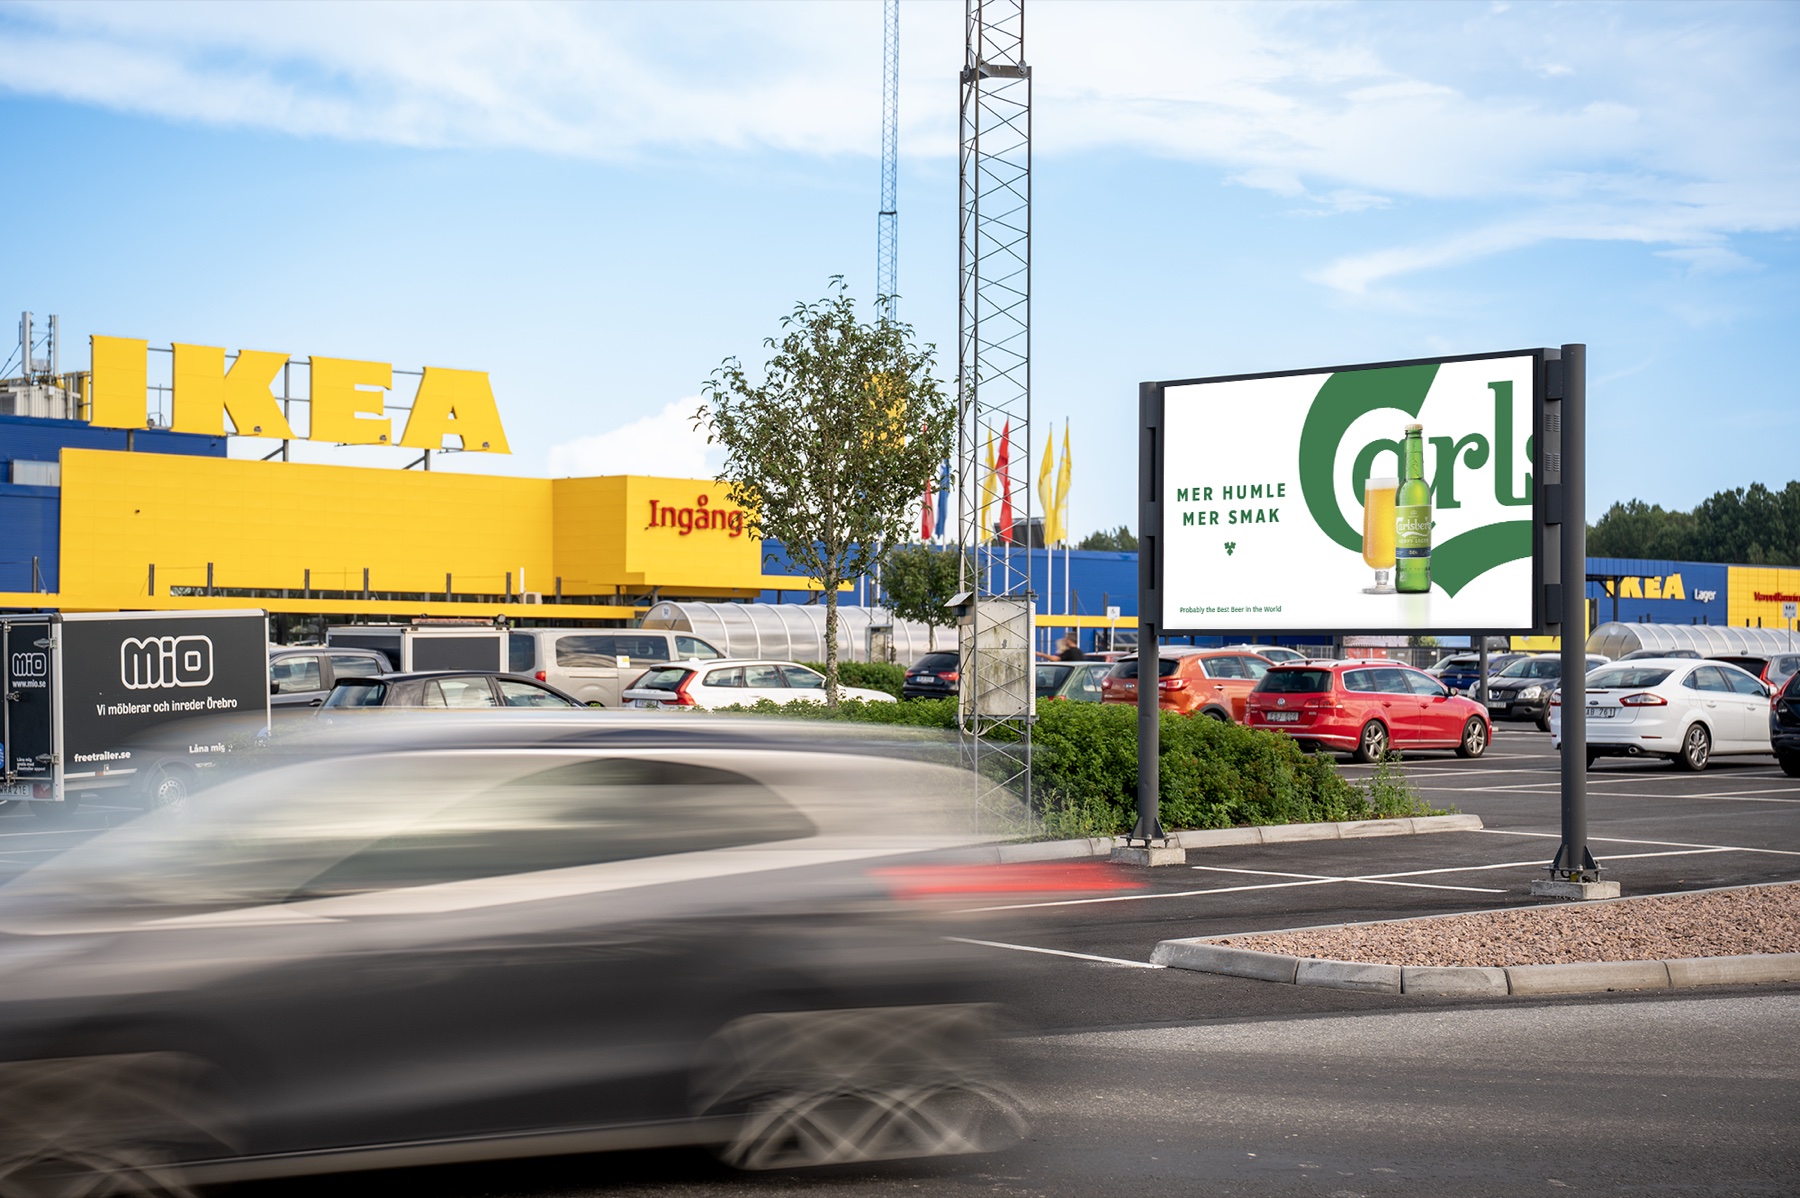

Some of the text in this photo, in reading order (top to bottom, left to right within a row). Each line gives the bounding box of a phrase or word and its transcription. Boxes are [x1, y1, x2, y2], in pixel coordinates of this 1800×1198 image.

[89, 335, 512, 454] IKEA
[1177, 483, 1286, 502] MER HUMLE
[648, 494, 743, 538] Ingång
[1183, 508, 1280, 526] MER SMAK
[1606, 573, 1686, 600] IKEA
[1694, 588, 1717, 603] Lager
[1180, 606, 1205, 615] Probably
[1264, 605, 1282, 613] World
[12, 679, 47, 688] www.mio.se
[96, 696, 238, 716] Vi möblerar och inreder Örebro
[74, 750, 131, 763] freetrailer.se
[189, 743, 209, 754] Låna
